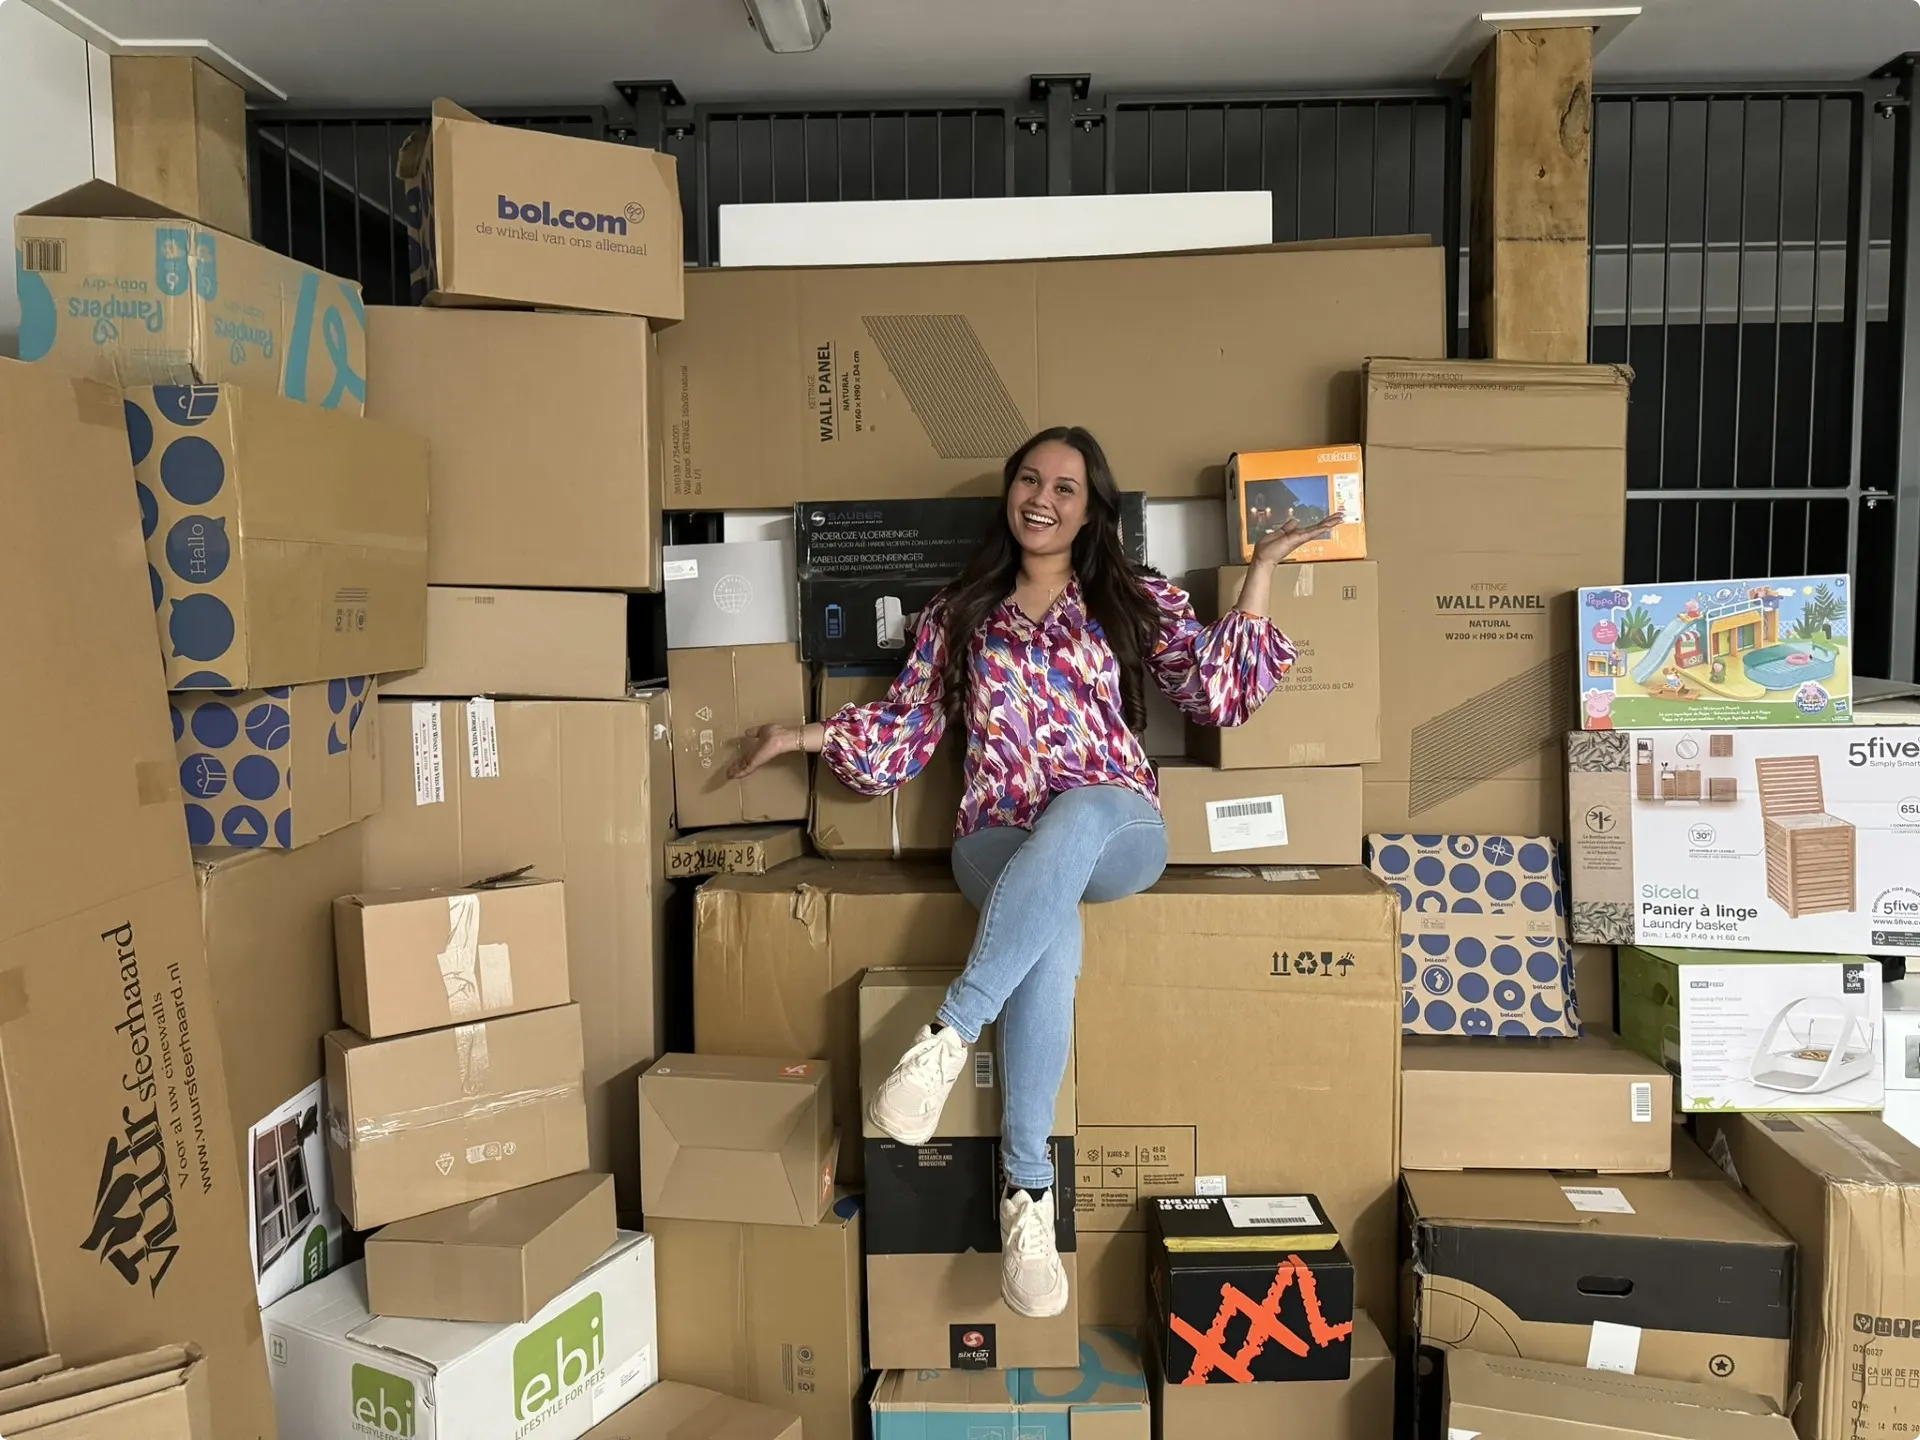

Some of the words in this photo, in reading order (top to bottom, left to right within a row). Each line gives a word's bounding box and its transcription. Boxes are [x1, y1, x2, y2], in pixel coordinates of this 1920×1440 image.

[497, 194, 627, 236] bol.com
[475, 221, 493, 236] de
[496, 225, 539, 242] winkel
[542, 231, 566, 246] van
[569, 236, 592, 249] ons
[595, 238, 648, 256] allemaal
[82, 277, 147, 293] baby-dry
[68, 297, 163, 333] Pampers
[214, 316, 274, 359] Pampers
[853, 350, 860, 363] cm
[817, 341, 832, 393] PANEL
[852, 364, 860, 376] D4
[841, 371, 850, 411] NATURAL
[1384, 392, 1400, 400] Box
[819, 396, 834, 442] WALL
[827, 511, 883, 521] SAUBER
[811, 531, 858, 542] SNOERLOZE
[859, 529, 920, 541] VLOERREINIGER
[187, 523, 206, 575] Hallo
[812, 554, 859, 564] KABELLOSER
[860, 553, 924, 563] BODENREINIGER
[1470, 582, 1508, 591] KETTINGE
[1436, 595, 1485, 609] WALL
[1489, 595, 1546, 609] PANEL
[1588, 593, 1613, 608] Peppa
[1614, 592, 1628, 606] Pig
[1469, 619, 1511, 628] NATURAL
[1445, 632, 1470, 640] W200
[1479, 632, 1497, 640] H90
[1506, 632, 1519, 640] D4
[1520, 632, 1534, 640] cm
[1342, 682, 1354, 690] CM
[1848, 737, 1920, 767] 5five
[1869, 760, 1896, 769] Simply
[1897, 760, 1920, 768] Smart
[1641, 884, 1700, 900] Sicela
[1642, 902, 1694, 916] Panier
[1700, 903, 1710, 917] à
[1716, 904, 1758, 921] linge
[1884, 900, 1918, 915] 5five
[1642, 918, 1692, 932] Laundry
[1696, 919, 1738, 932] basket
[153, 992, 175, 1080] cinewalls
[166, 961, 212, 1194] www.vuursfeerhaard.nl
[166, 1084, 180, 1113] uw
[170, 1115, 184, 1134] al
[175, 1137, 189, 1190] Voor
[1170, 1254, 1353, 1385] XXL
[519, 1315, 602, 1415] ebi
[1867, 1366, 1879, 1376] CA
[1881, 1367, 1893, 1377] UK
[1895, 1368, 1906, 1377] DE
[1909, 1369, 1919, 1378] FR
[354, 1387, 412, 1438] ebi
[514, 1397, 564, 1440] LIFESTYLE
[564, 1386, 583, 1407] FOR
[584, 1368, 606, 1393] PETS
[1892, 1422, 1908, 1431] KGS
